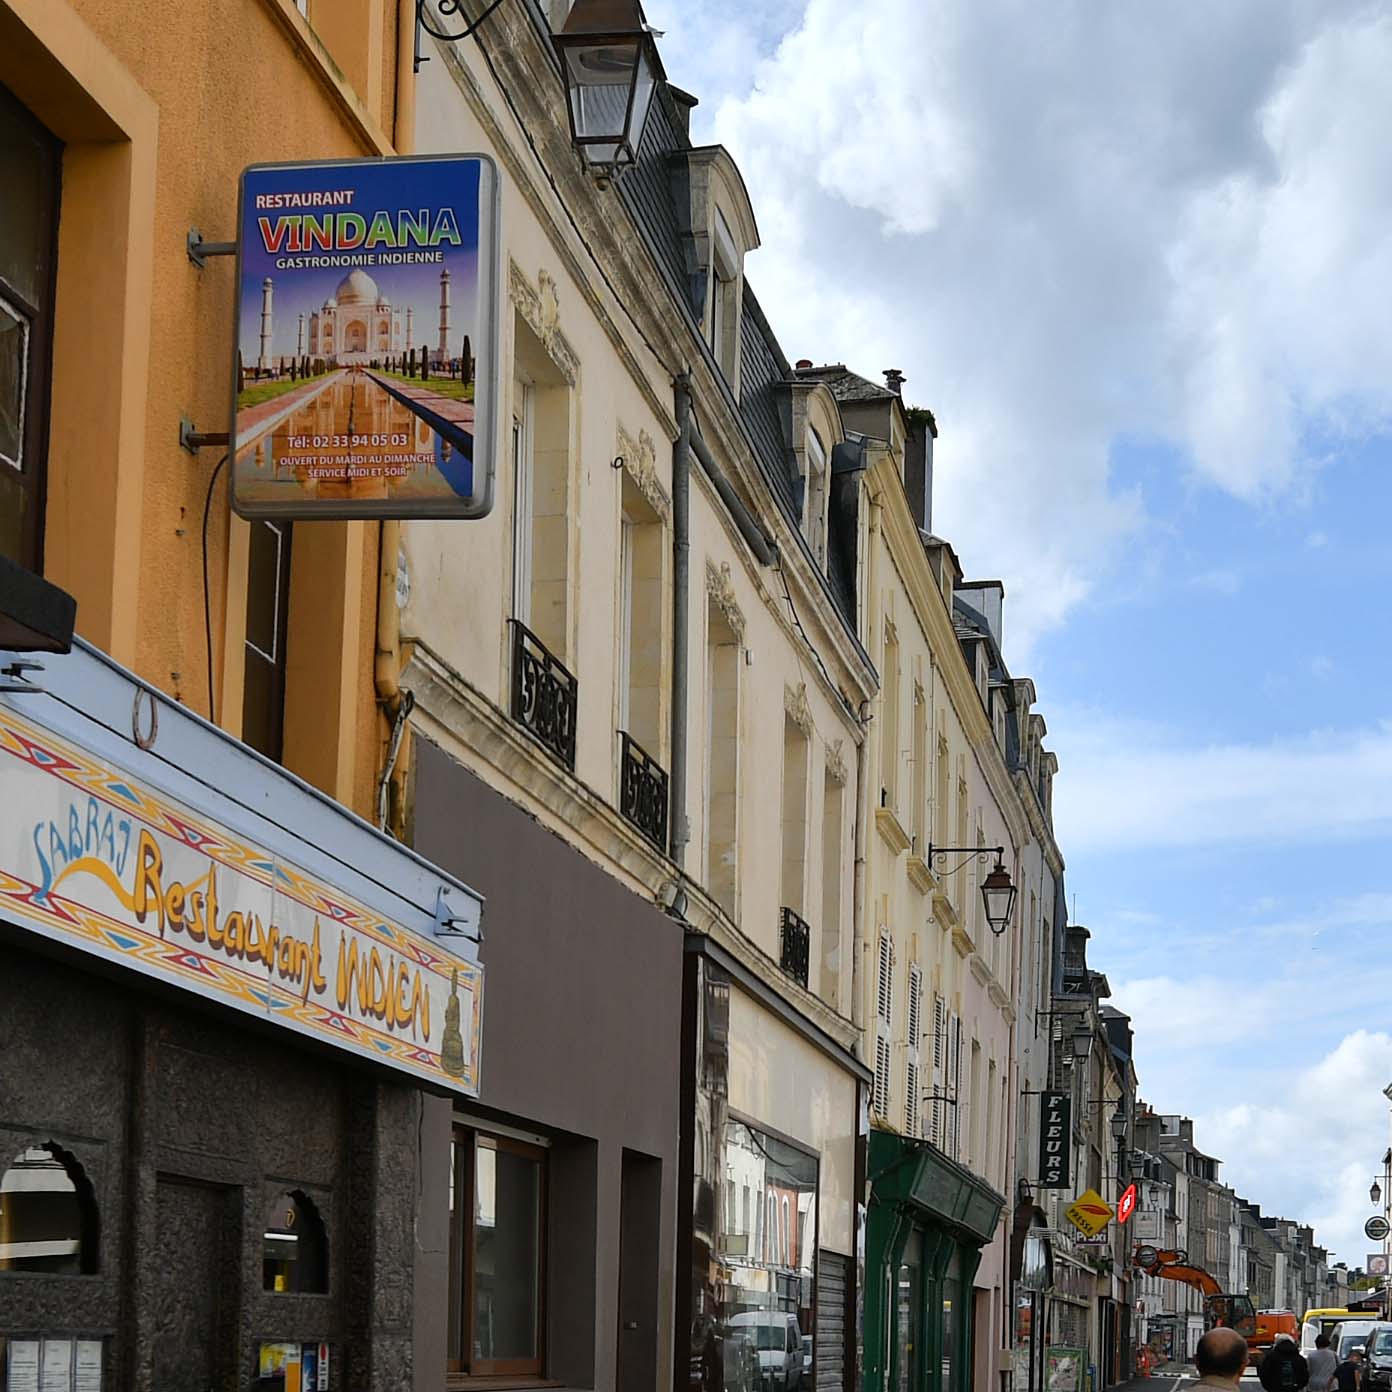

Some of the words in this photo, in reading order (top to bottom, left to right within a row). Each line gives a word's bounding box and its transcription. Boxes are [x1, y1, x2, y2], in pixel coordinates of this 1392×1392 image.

[256, 190, 354, 209] RESTAURANT
[258, 208, 462, 253] VINDANA
[275, 253, 376, 270] GASTRONOMIE
[378, 251, 443, 266] INDIENNE
[288, 436, 310, 448] Tél:
[312, 436, 329, 448] 02
[332, 435, 349, 447] 33
[351, 435, 368, 447] 94
[371, 435, 388, 446] 05
[391, 434, 408, 446] 03
[280, 455, 317, 466] OUVERT
[319, 456, 334, 465] DU
[336, 455, 367, 465] MARDI
[369, 455, 382, 464] AU
[384, 454, 436, 464] DIMANCHE
[308, 468, 346, 478] SERVICE
[348, 468, 369, 477] MIDI
[371, 467, 382, 476] ET
[384, 467, 407, 476] SOIR
[33, 796, 132, 906] SABRAJ
[135, 828, 327, 1006] Restaurant
[1046, 1095, 1064, 1183] FLEURS
[1069, 1207, 1095, 1234] PRESSE
